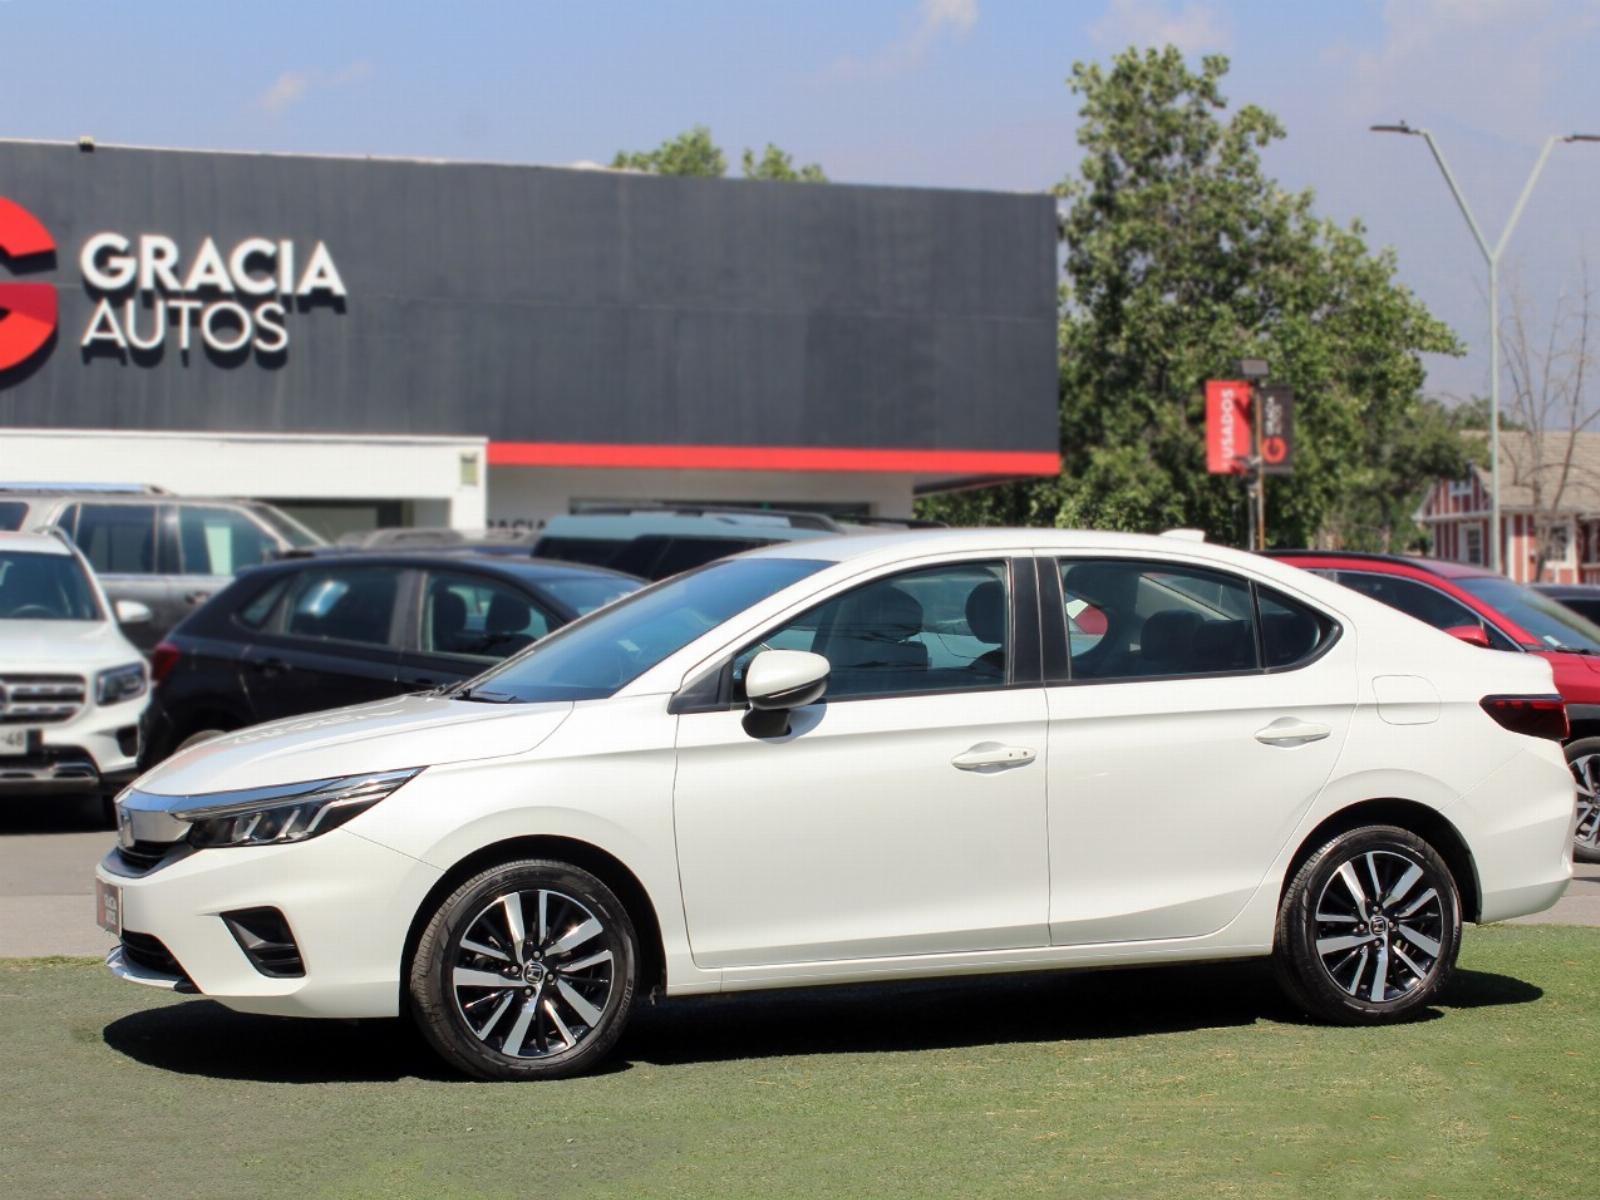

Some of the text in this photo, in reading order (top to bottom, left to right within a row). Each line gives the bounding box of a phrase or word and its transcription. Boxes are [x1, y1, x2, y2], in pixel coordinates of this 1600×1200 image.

[80, 232, 347, 295] GRACIA
[81, 297, 288, 351] AUTOS
[1221, 389, 1234, 459] USADOS
